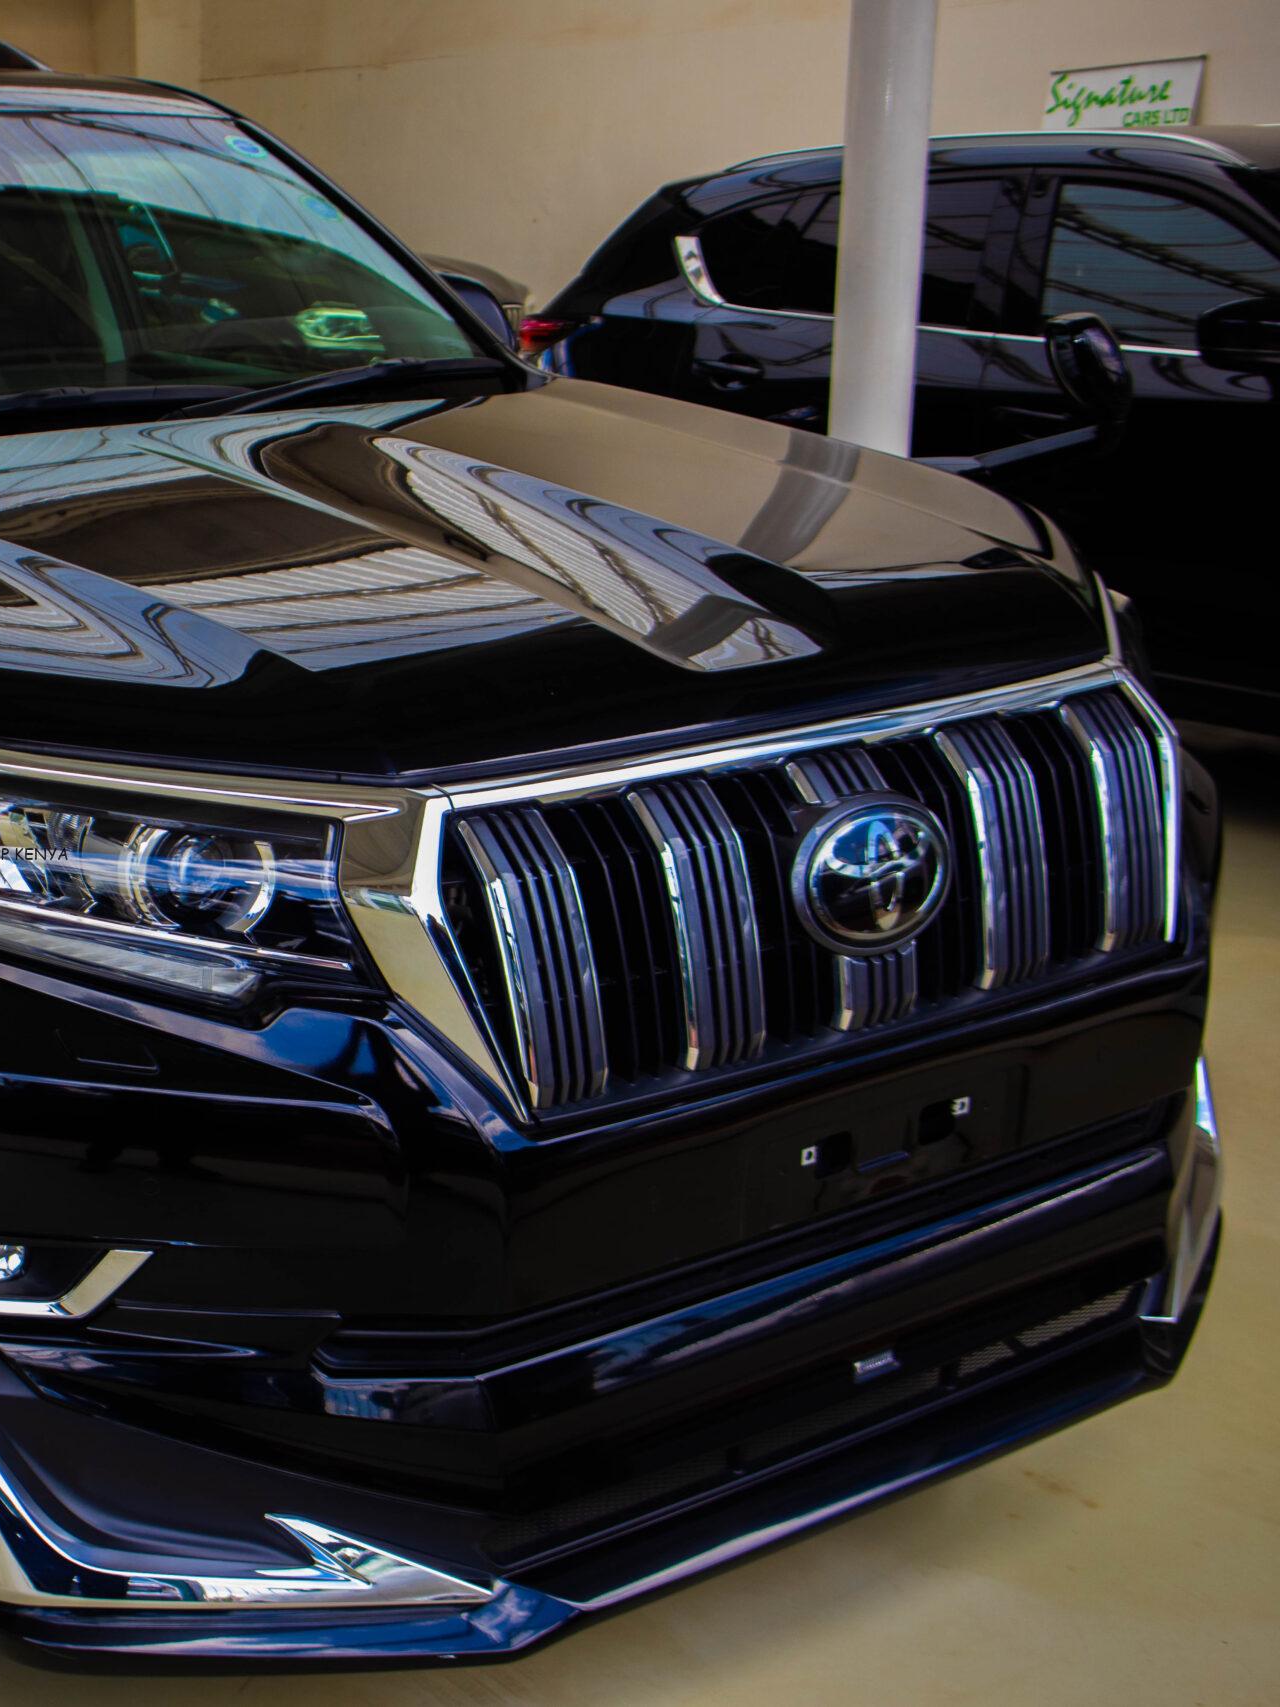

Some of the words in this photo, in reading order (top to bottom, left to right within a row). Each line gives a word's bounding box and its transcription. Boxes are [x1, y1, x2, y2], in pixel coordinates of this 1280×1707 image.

[1046, 73, 1172, 127] Signature
[1122, 109, 1161, 127] CARS
[1163, 107, 1191, 125] LTD
